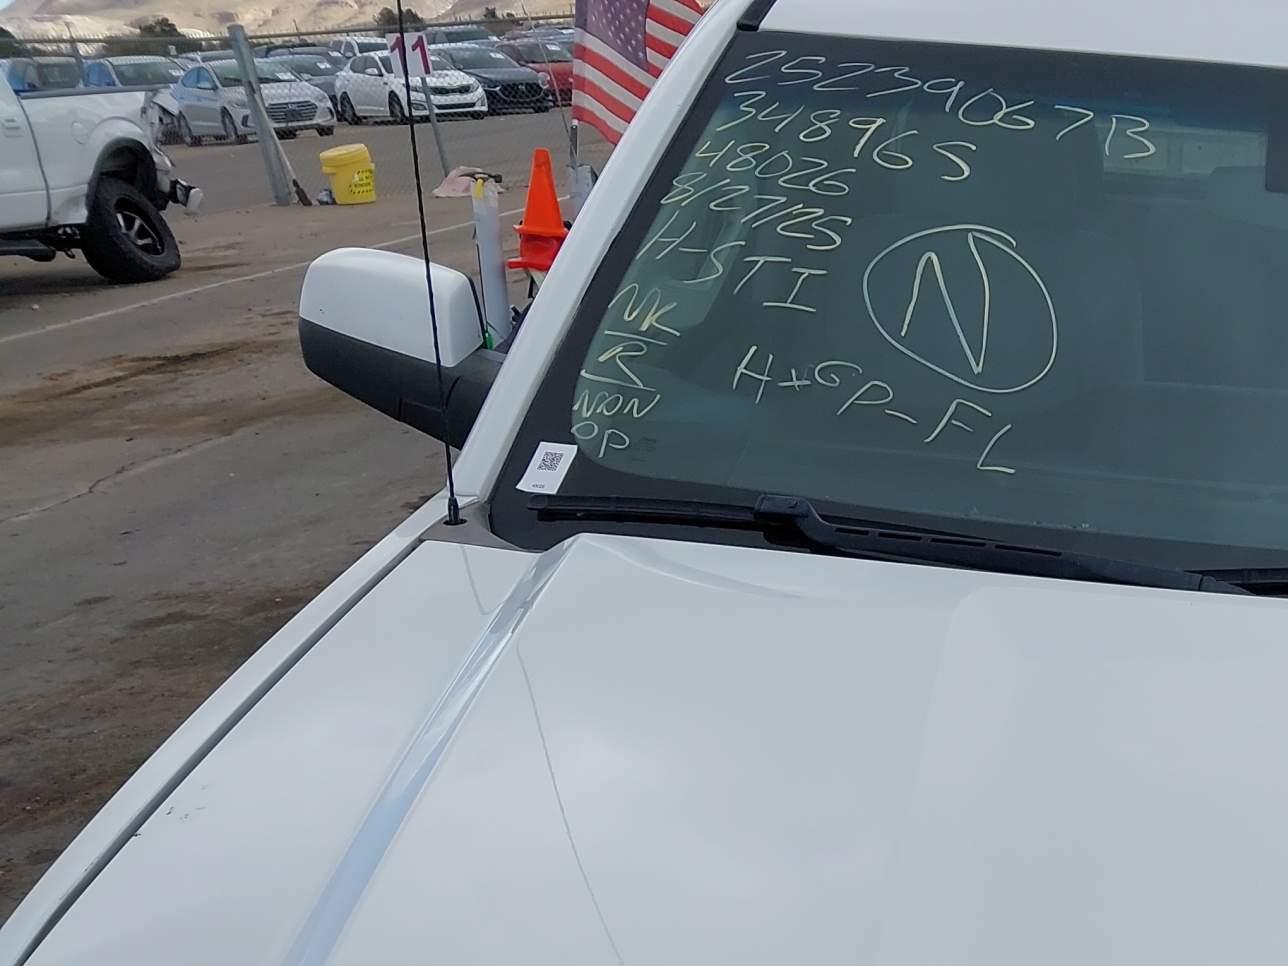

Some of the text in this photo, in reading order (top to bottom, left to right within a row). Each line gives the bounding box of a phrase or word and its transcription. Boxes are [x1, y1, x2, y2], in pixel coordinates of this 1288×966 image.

[696, 140, 857, 196] 48026
[660, 172, 853, 251] 8/27/25
[571, 388, 662, 419] NON
[570, 421, 631, 459] OP
